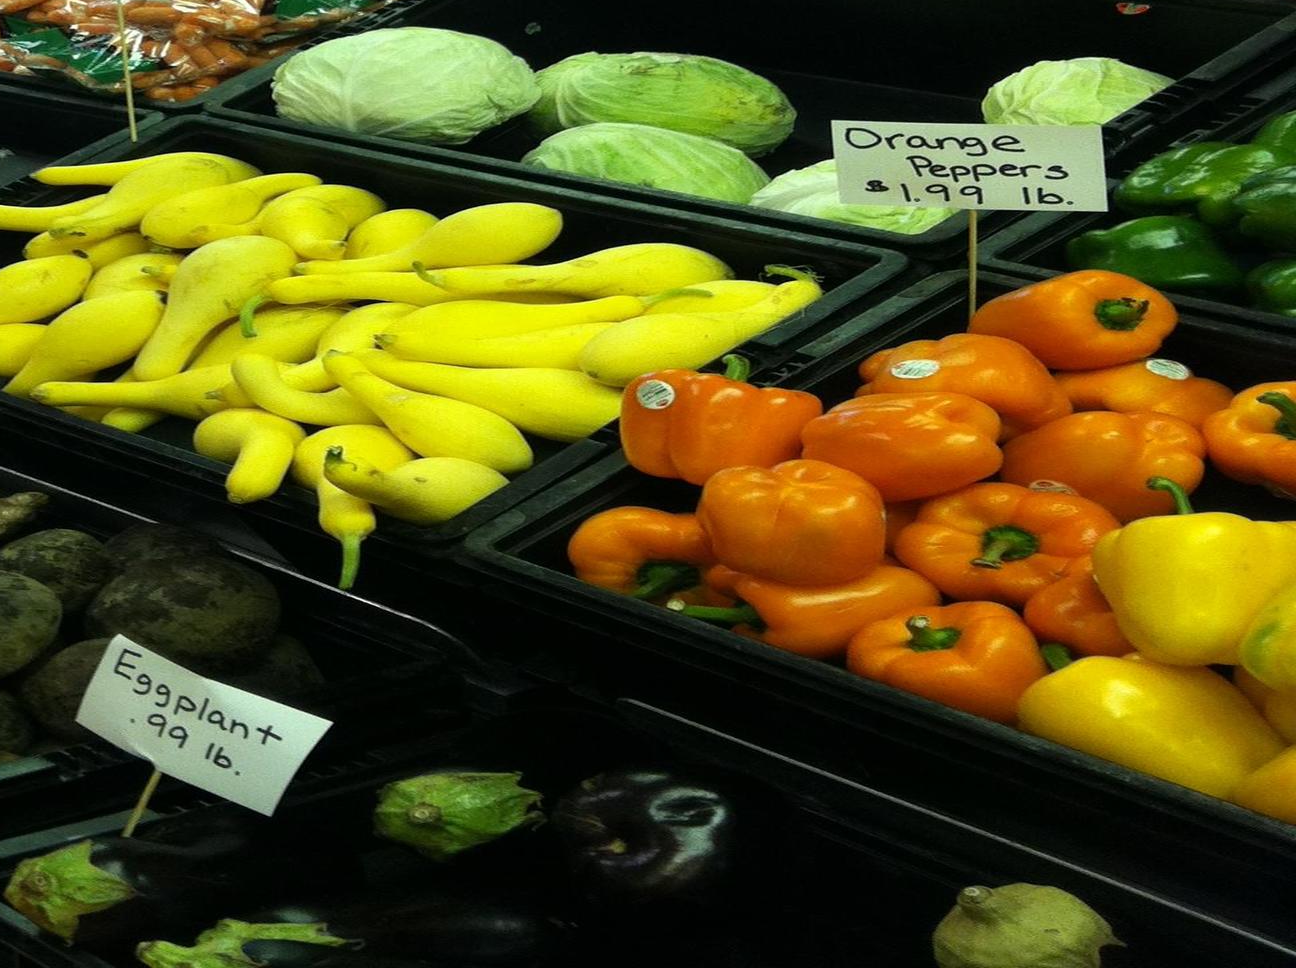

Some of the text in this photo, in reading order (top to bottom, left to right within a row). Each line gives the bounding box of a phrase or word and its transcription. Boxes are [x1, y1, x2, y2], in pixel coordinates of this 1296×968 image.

[844, 127, 1026, 157] Orange
[906, 155, 1069, 183] Peppers
[1022, 185, 1074, 206] lb.
[113, 648, 283, 745] Eggplant
[129, 713, 241, 776] .99 lb.
